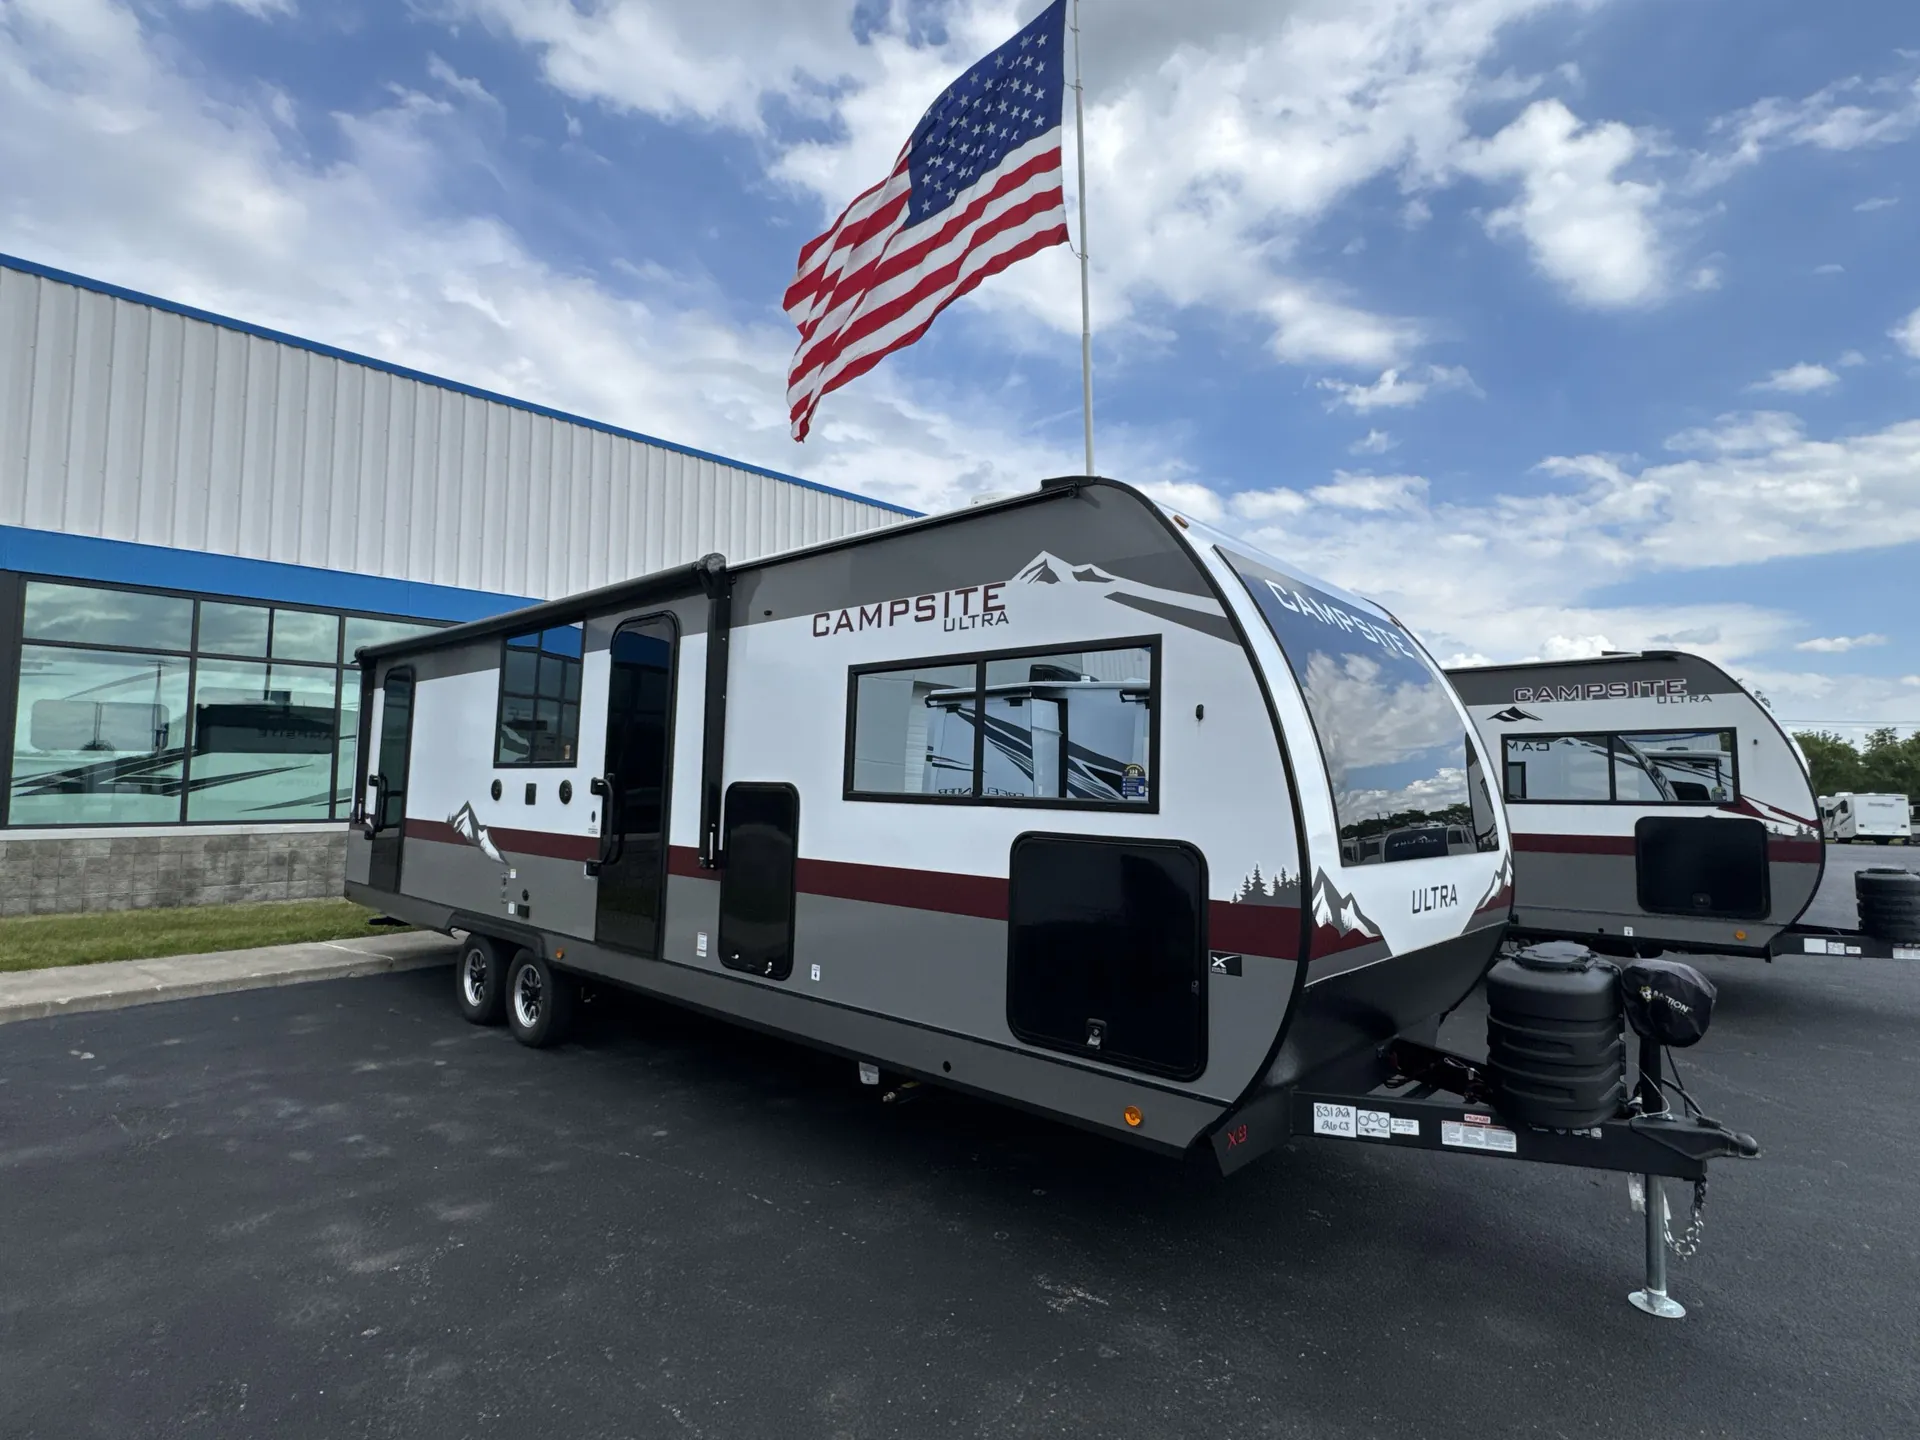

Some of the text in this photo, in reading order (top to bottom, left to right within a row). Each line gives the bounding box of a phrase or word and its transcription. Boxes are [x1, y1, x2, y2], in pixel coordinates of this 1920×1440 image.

[813, 582, 1006, 637] CAMPSITE
[943, 611, 1009, 632] ULTRA
[1265, 579, 1415, 659] CAMPSITE
[1513, 678, 1687, 703] CAMPSITE
[1657, 694, 1712, 704] ULTRA
[1412, 884, 1458, 914] ULTRA
